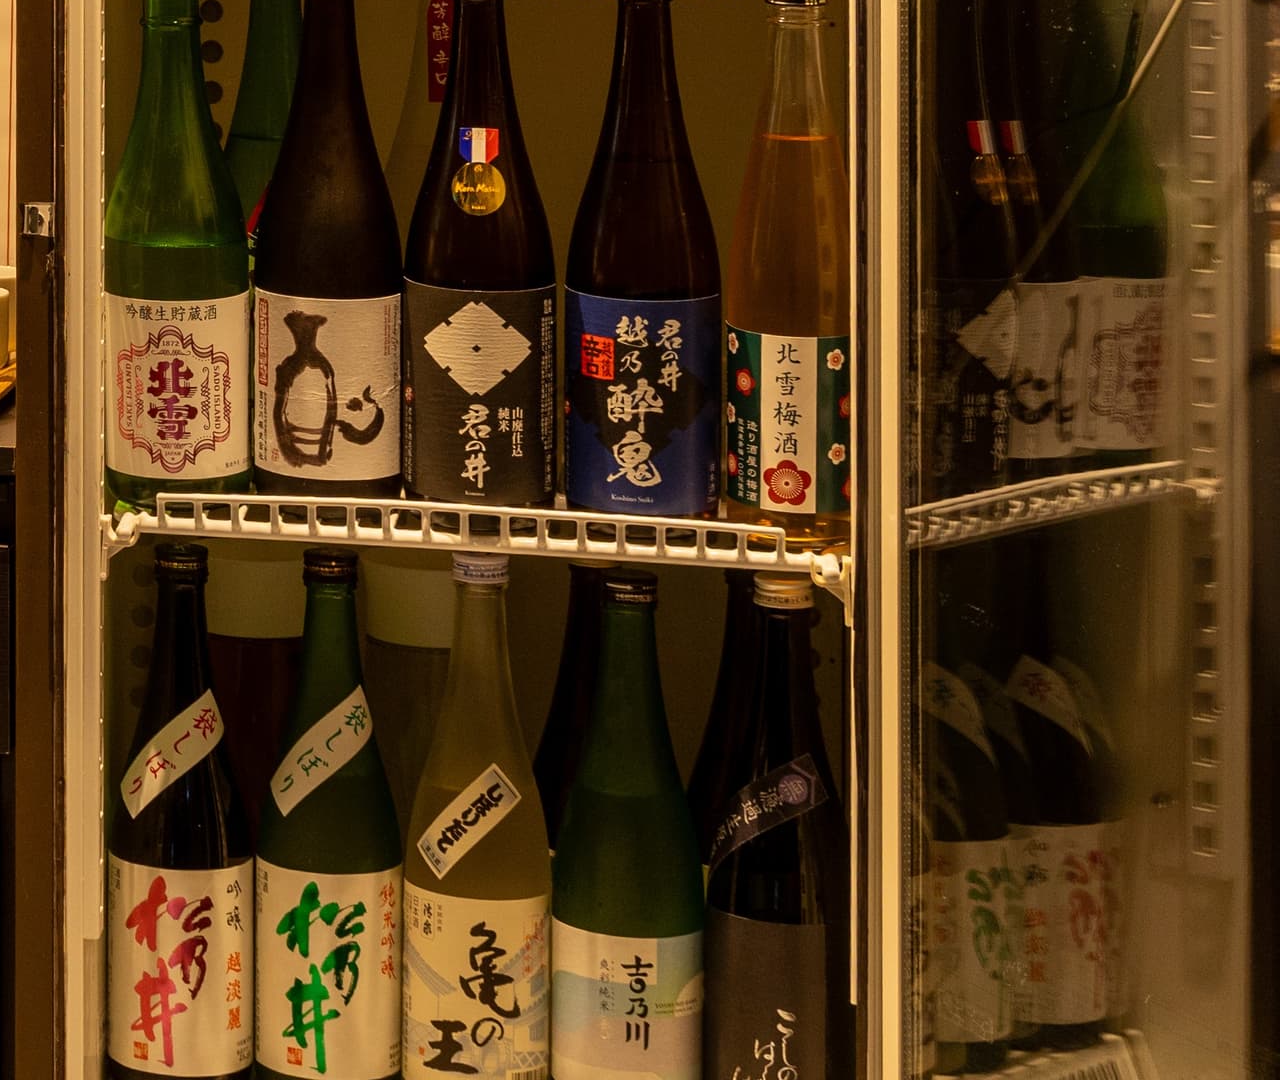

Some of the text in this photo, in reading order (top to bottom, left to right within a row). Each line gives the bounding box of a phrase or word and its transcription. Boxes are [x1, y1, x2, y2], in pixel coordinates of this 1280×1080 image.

[125, 303, 218, 322] 吟醸生貯蔵酒
[655, 319, 683, 393] 君の井
[146, 358, 198, 441] 北雪
[497, 407, 511, 433] 純米
[606, 315, 665, 488] 越乃酔鬼
[773, 343, 803, 457] 北雪梅酒
[458, 403, 492, 489] 君の井
[226, 951, 243, 1031] 越淡麗
[620, 954, 655, 1051] 吉乃川
